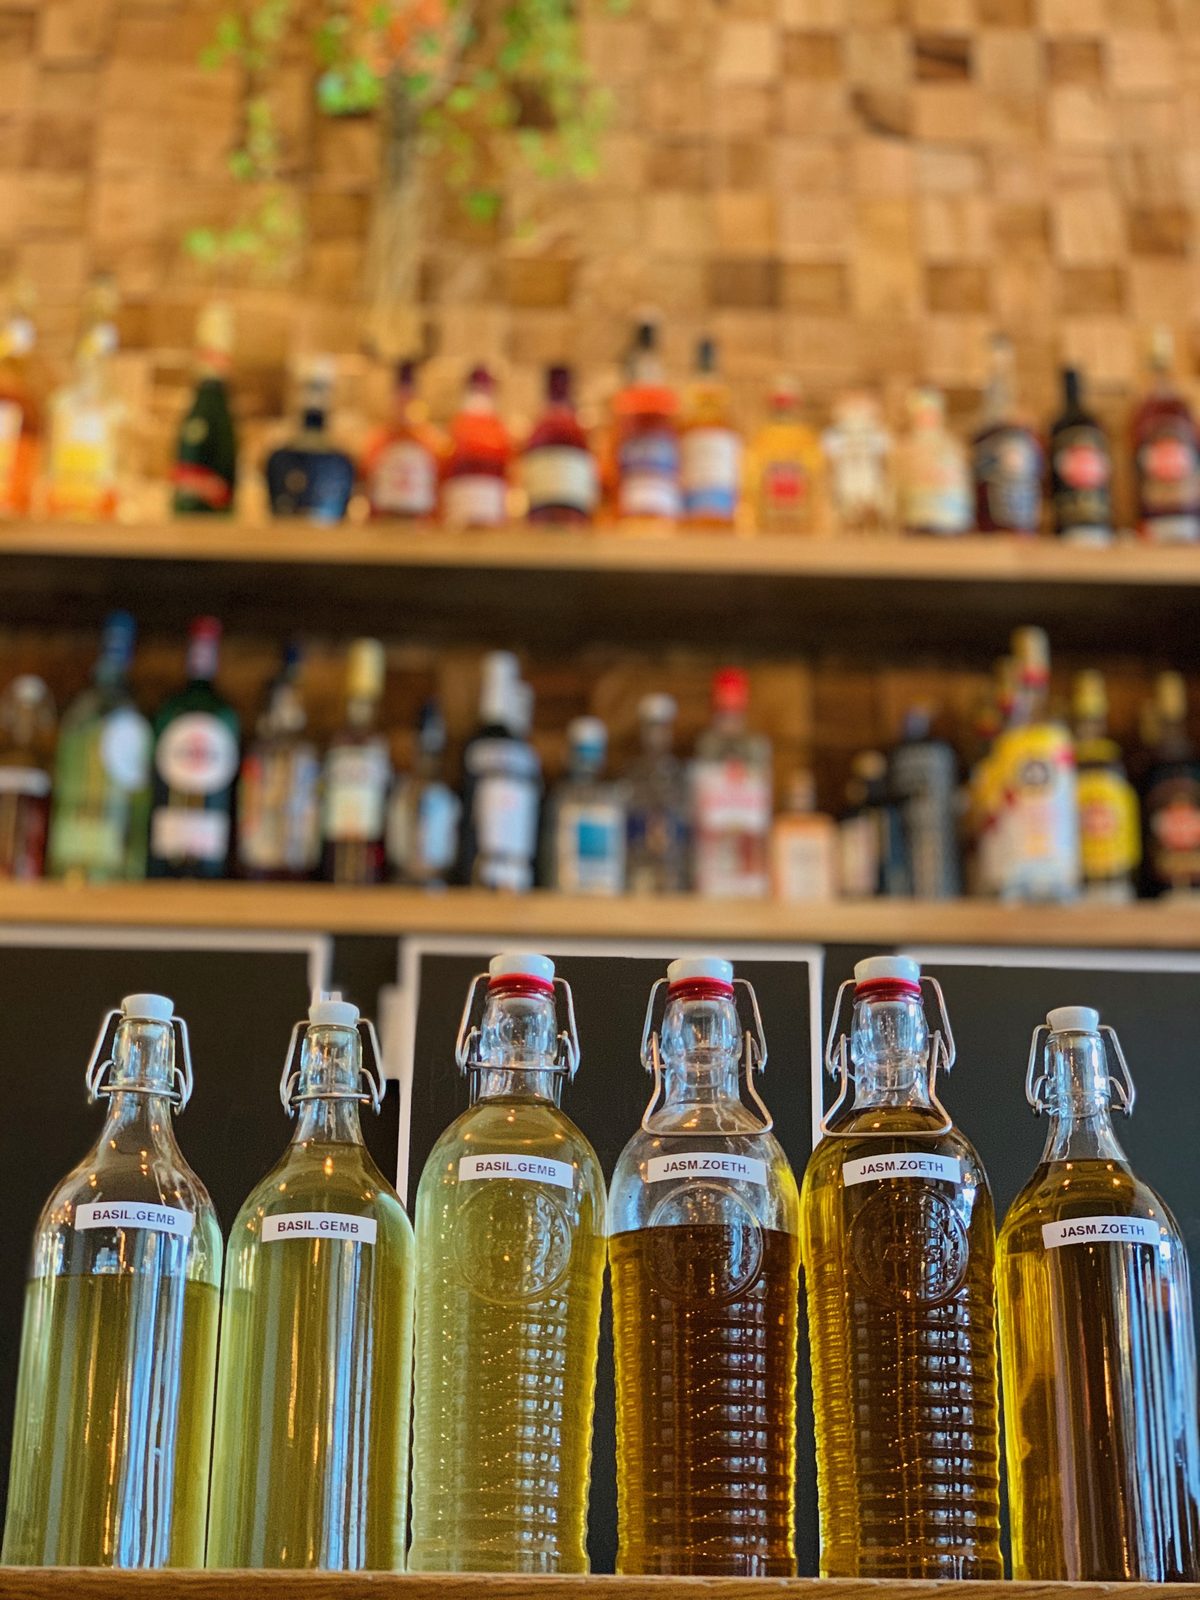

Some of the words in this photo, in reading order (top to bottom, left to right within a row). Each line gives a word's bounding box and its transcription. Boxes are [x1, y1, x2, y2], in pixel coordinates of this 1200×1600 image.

[475, 1161, 556, 1176] BASIL.GEMB
[859, 1160, 944, 1175] JASM.ZOETH
[92, 1210, 175, 1225] BASIL.GEMB
[277, 1221, 360, 1234] BASIL.GEMB
[1060, 1223, 1145, 1238] JASM.ZOETH
